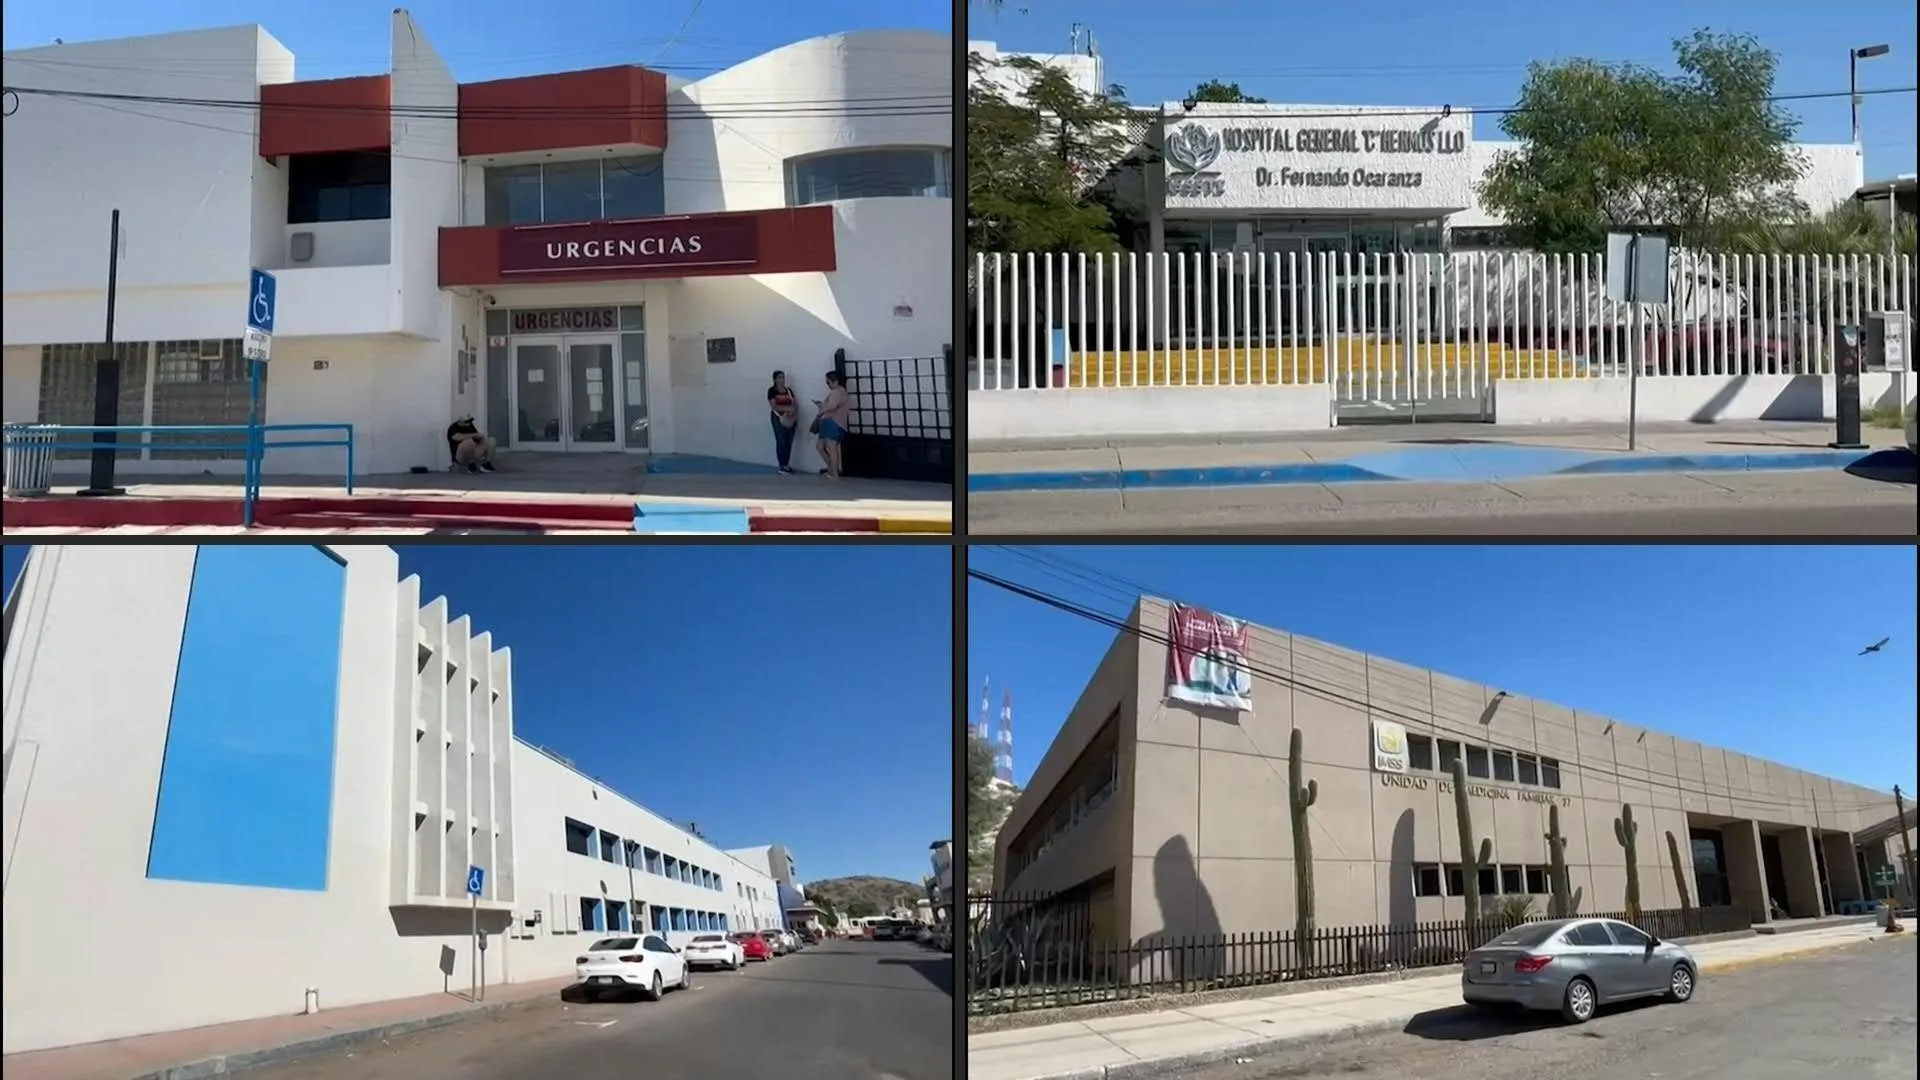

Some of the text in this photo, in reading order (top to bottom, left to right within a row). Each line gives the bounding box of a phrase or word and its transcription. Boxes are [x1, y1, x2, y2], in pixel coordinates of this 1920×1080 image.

[1222, 127, 1294, 152] HOSPITAL
[1296, 129, 1360, 152] GENERAL
[1380, 129, 1465, 154] HERMOSLLO
[1255, 166, 1422, 187] Dr. Fernando Ocaranza
[547, 235, 702, 259] URGENCIAS
[514, 310, 613, 330] URGENCIAS
[1381, 774, 1428, 791] UNIDAD
